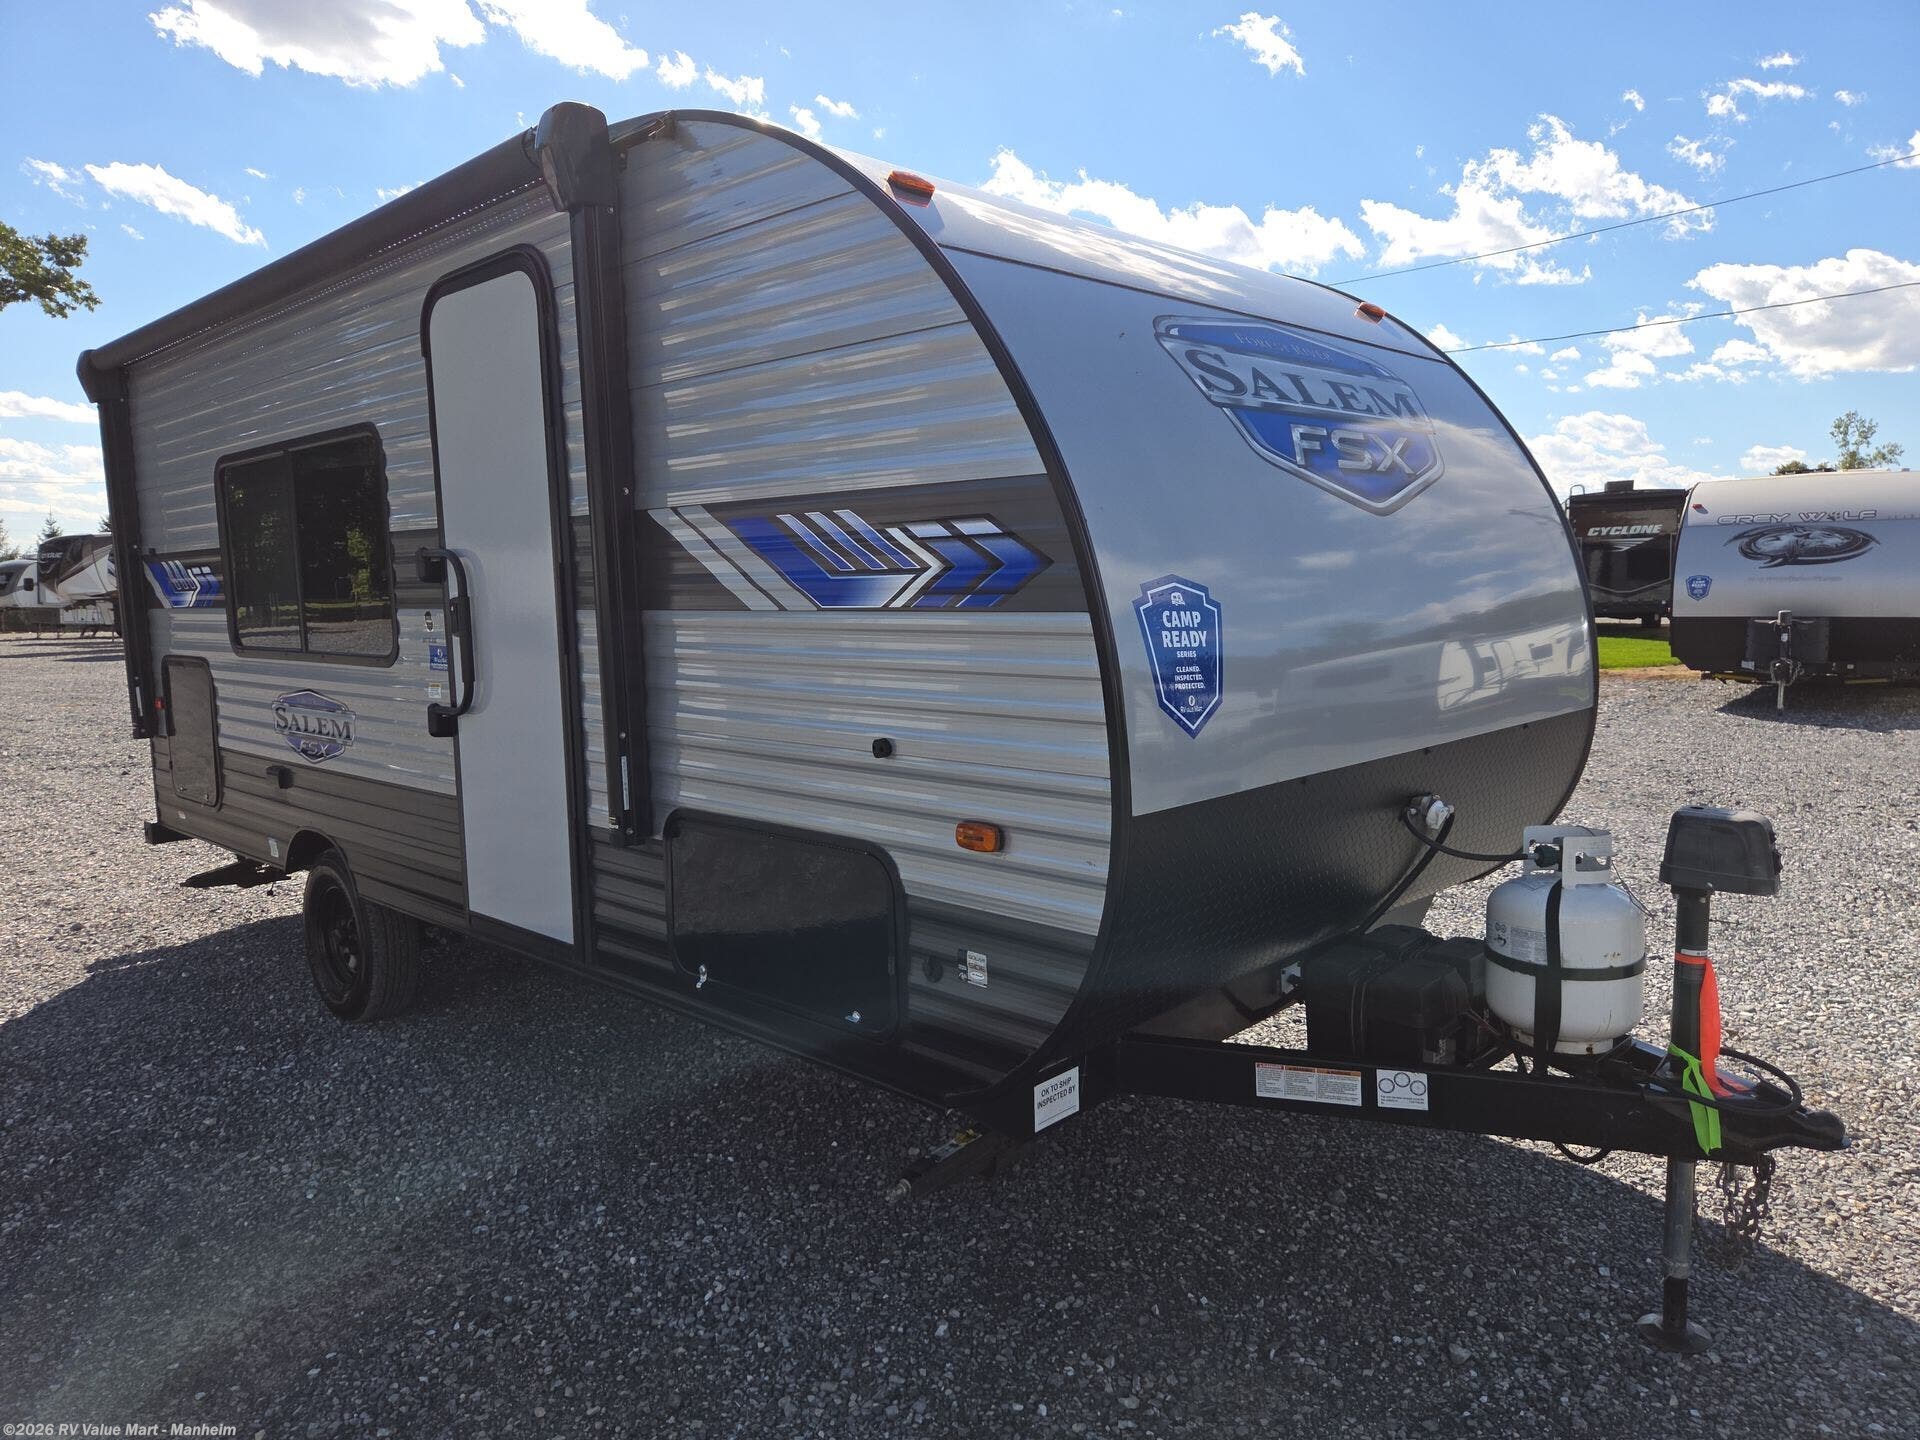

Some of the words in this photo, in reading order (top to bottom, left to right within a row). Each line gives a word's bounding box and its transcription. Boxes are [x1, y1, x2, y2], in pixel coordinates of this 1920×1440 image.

[1185, 350, 1419, 419] SALEM
[1290, 423, 1417, 476] FSX
[1717, 513, 1790, 525] GREY
[1587, 524, 1663, 536] CYCLONE
[1162, 610, 1201, 628] CAMP
[1161, 630, 1207, 648] READY
[1176, 650, 1197, 658] SERIES
[275, 706, 351, 740] SALEM
[300, 739, 330, 758] FSX
[1041, 1087, 1050, 1097] OK
[1051, 1083, 1059, 1092] TO
[1059, 1077, 1072, 1088] SHIP
[1037, 1089, 1068, 1109] INSPECTED
[1068, 1085, 1076, 1094] BY
